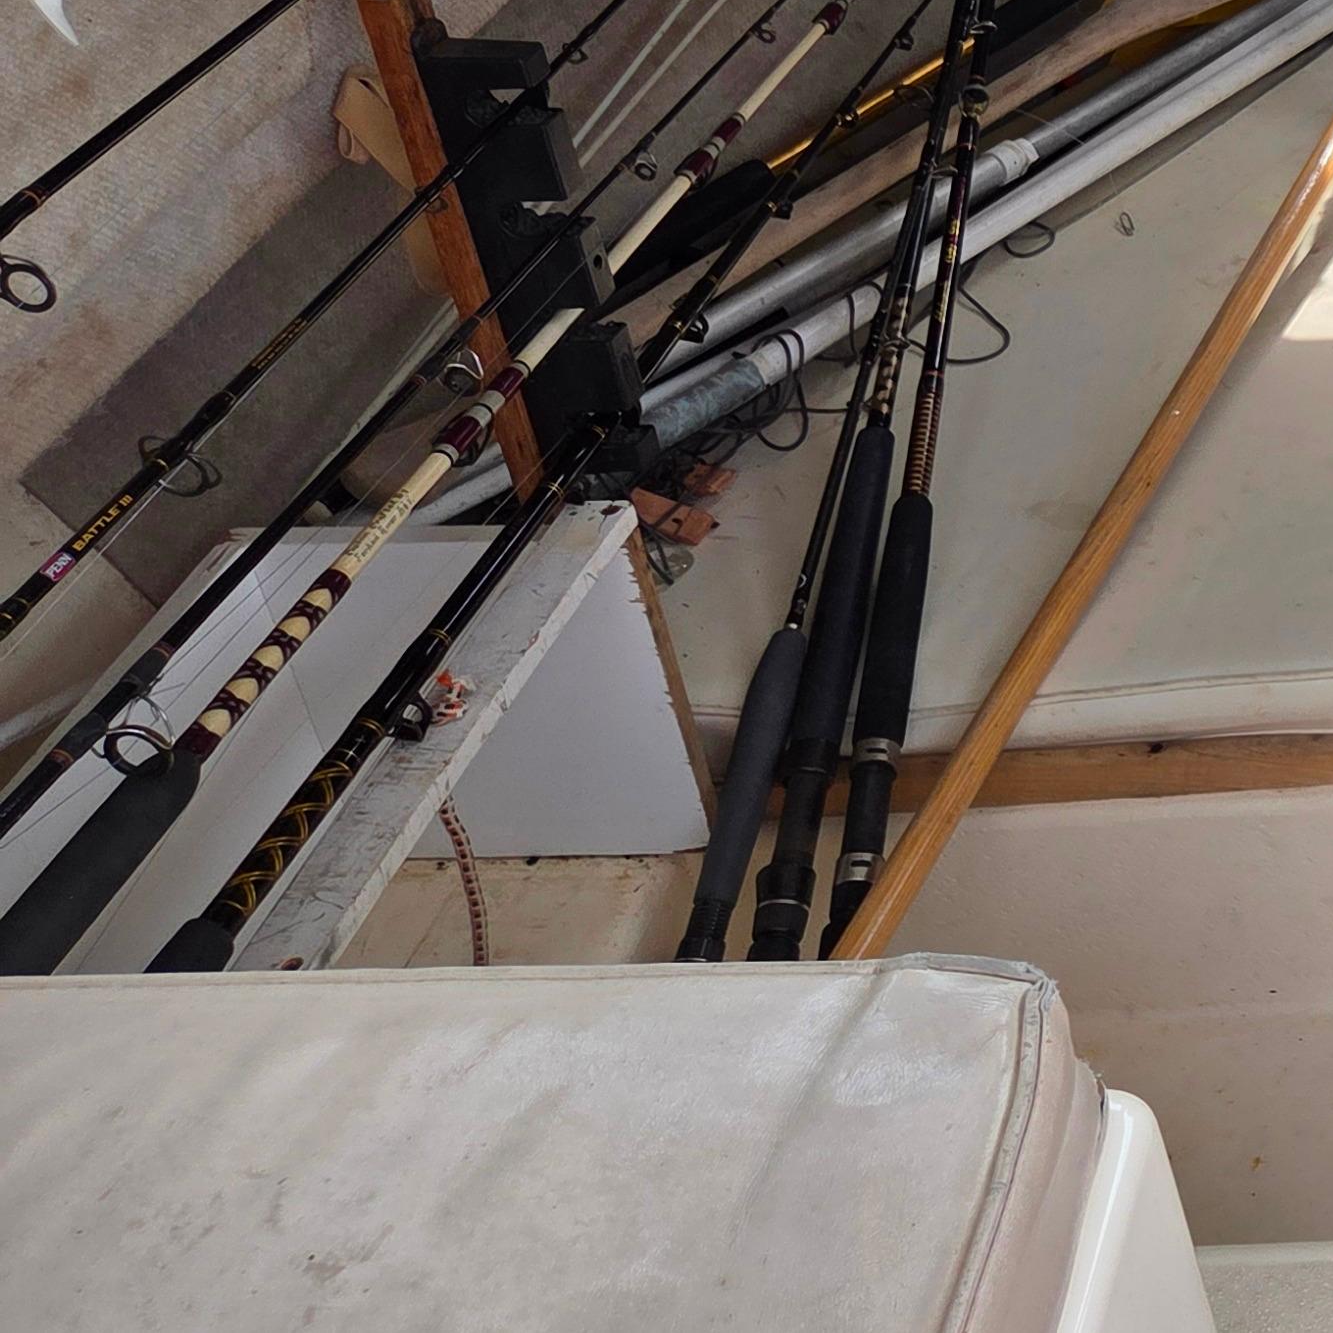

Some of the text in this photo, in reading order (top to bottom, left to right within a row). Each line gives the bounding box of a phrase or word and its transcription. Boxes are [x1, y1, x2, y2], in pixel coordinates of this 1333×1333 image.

[72, 494, 134, 552] BATTLE III
[45, 552, 72, 578] PENN
